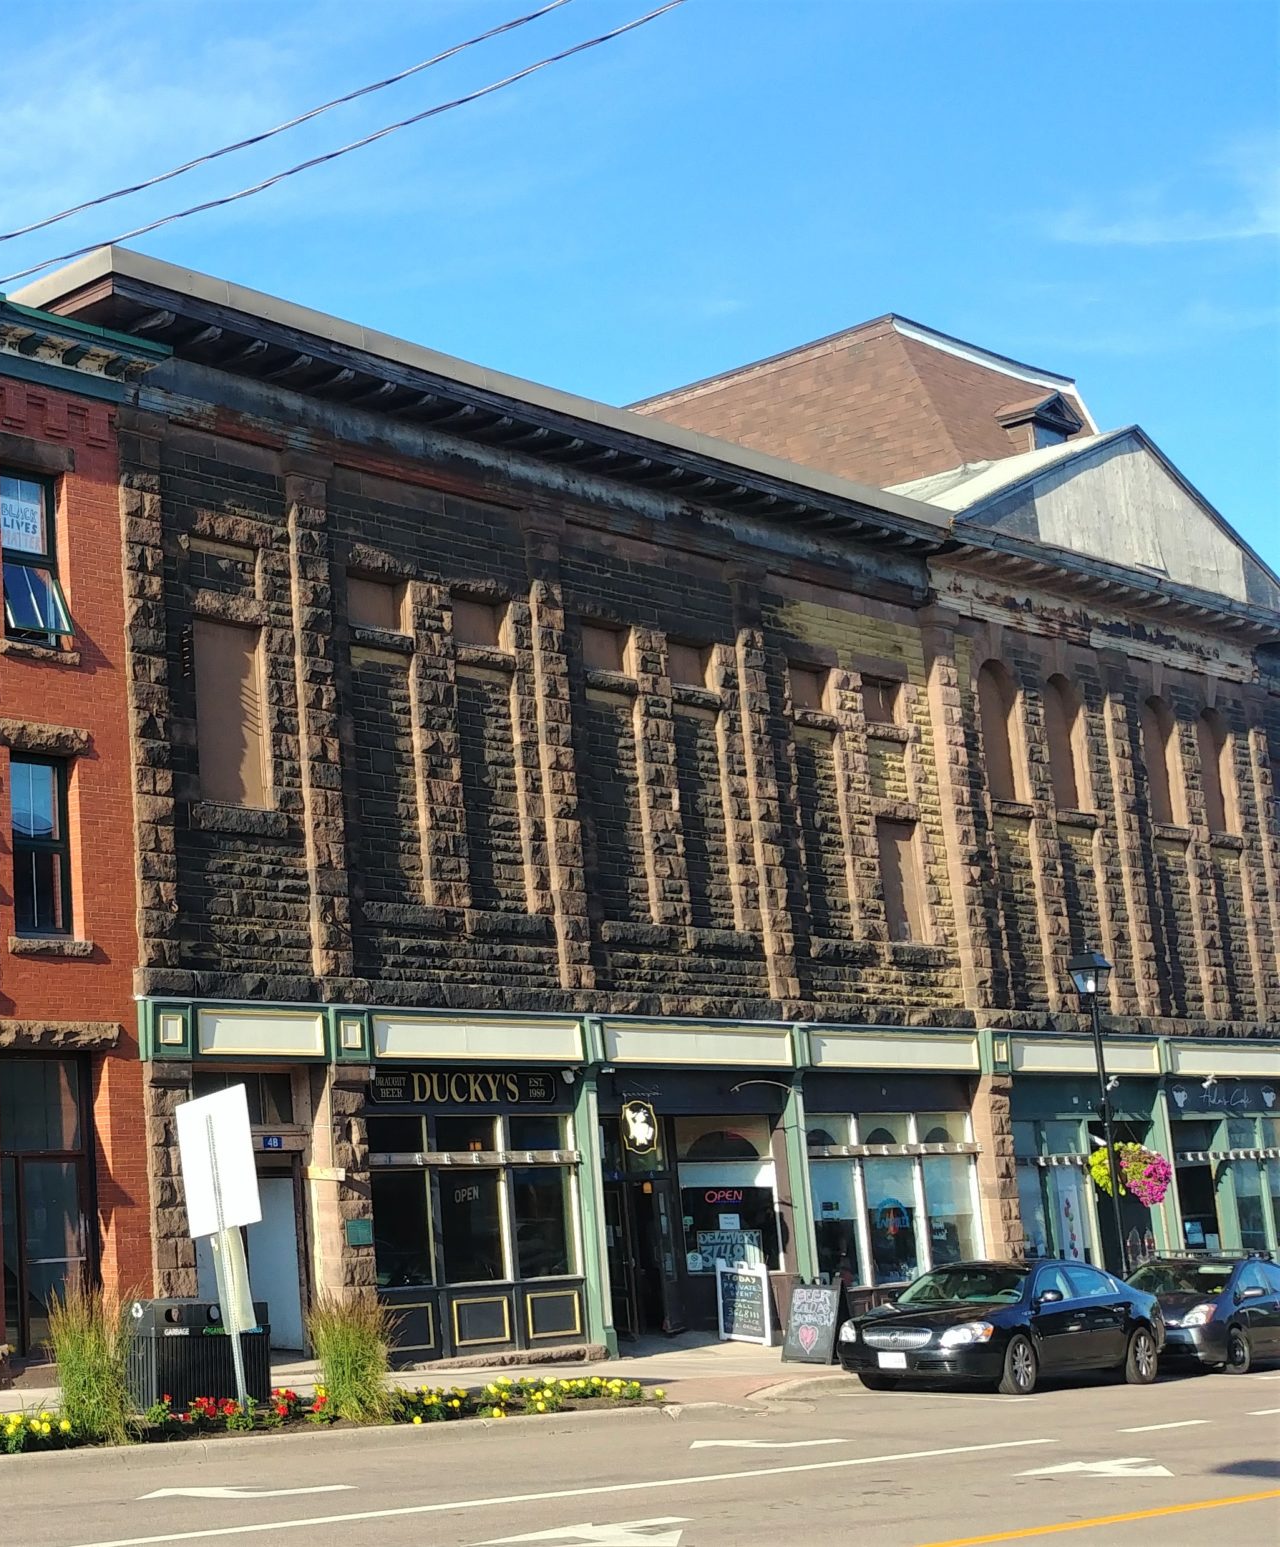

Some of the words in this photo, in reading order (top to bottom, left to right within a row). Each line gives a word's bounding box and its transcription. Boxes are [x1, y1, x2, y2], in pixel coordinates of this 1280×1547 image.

[1, 503, 38, 523] BLACK
[3, 517, 37, 534] LIVES
[380, 1088, 403, 1098] BEER
[411, 1072, 520, 1102] DUCKY'S
[455, 1186, 479, 1203] OPEN
[705, 1190, 743, 1203] OPEN
[699, 1231, 760, 1246] DELIVERY
[725, 1273, 756, 1284] TODAY
